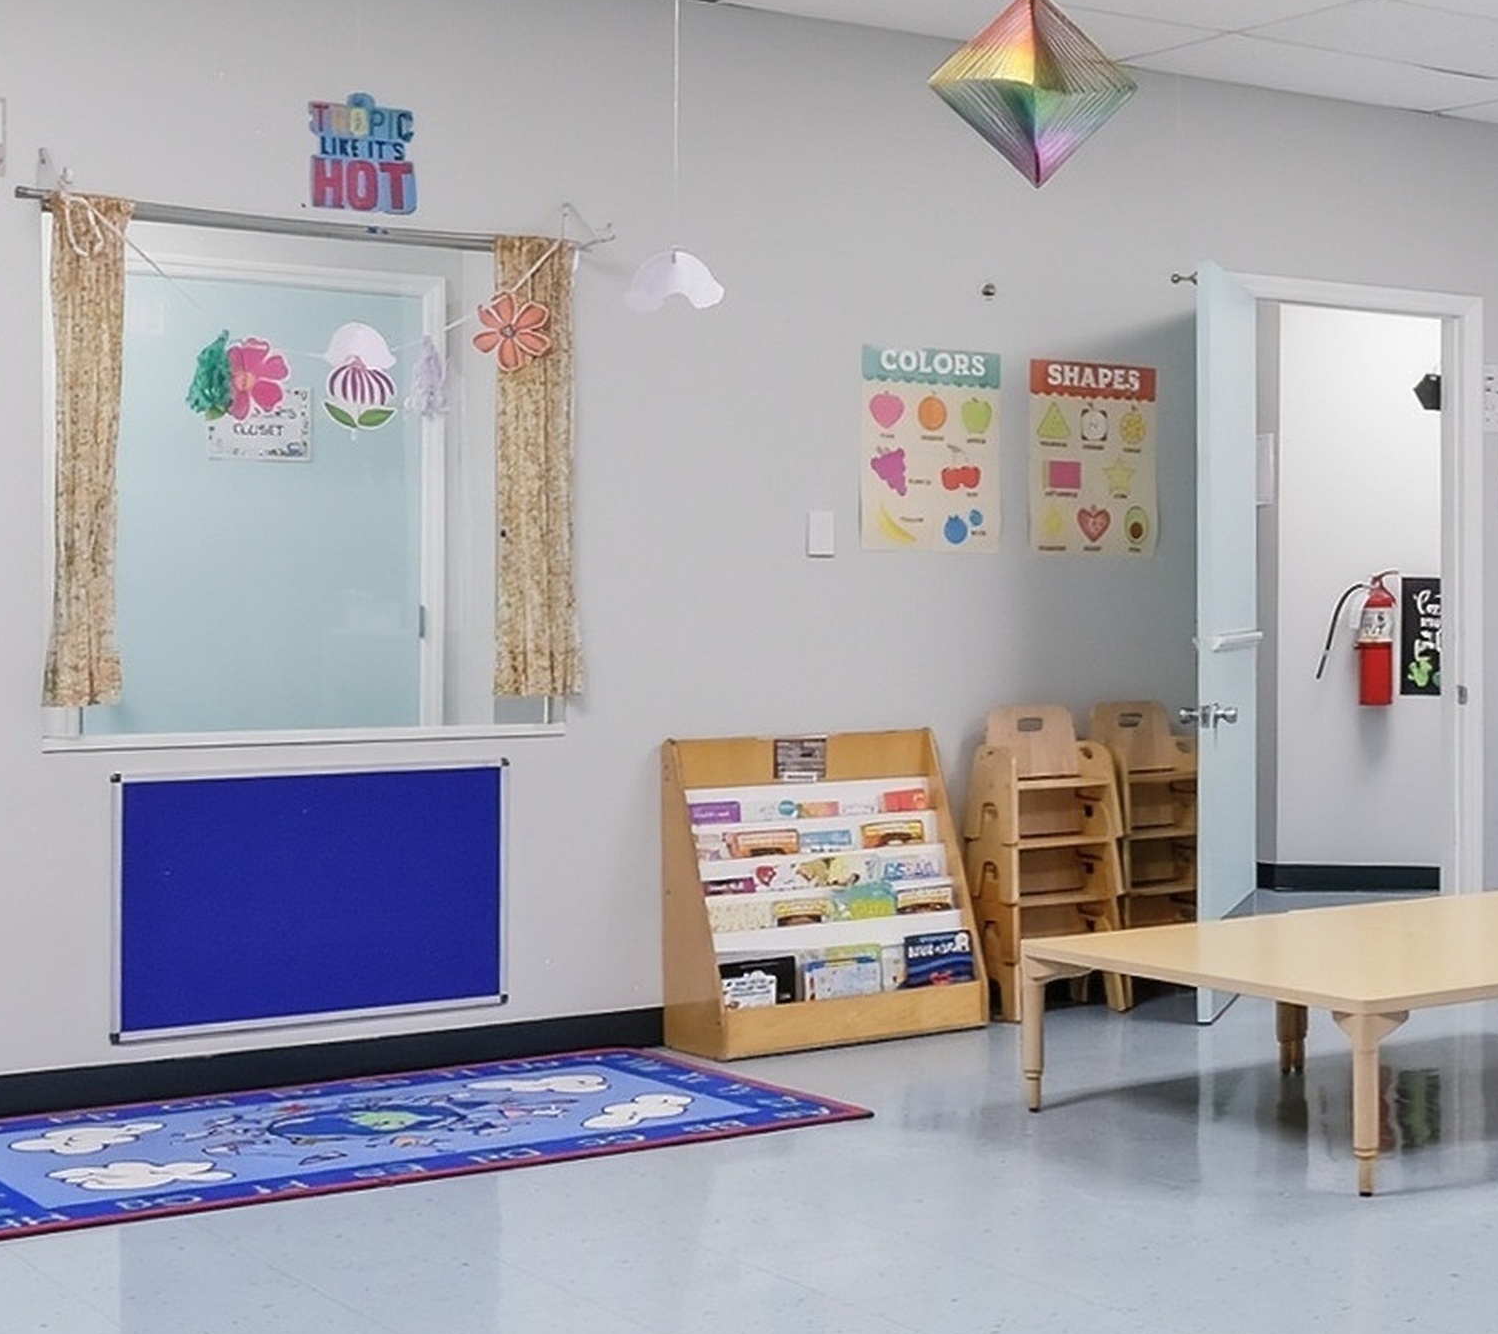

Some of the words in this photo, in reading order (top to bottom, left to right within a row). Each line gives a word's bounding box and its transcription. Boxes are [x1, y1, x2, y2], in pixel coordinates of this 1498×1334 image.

[320, 136, 361, 158] LIKE
[311, 157, 413, 211] HOT
[881, 349, 986, 377] COLORS
[1047, 364, 1141, 391] SHAPES
